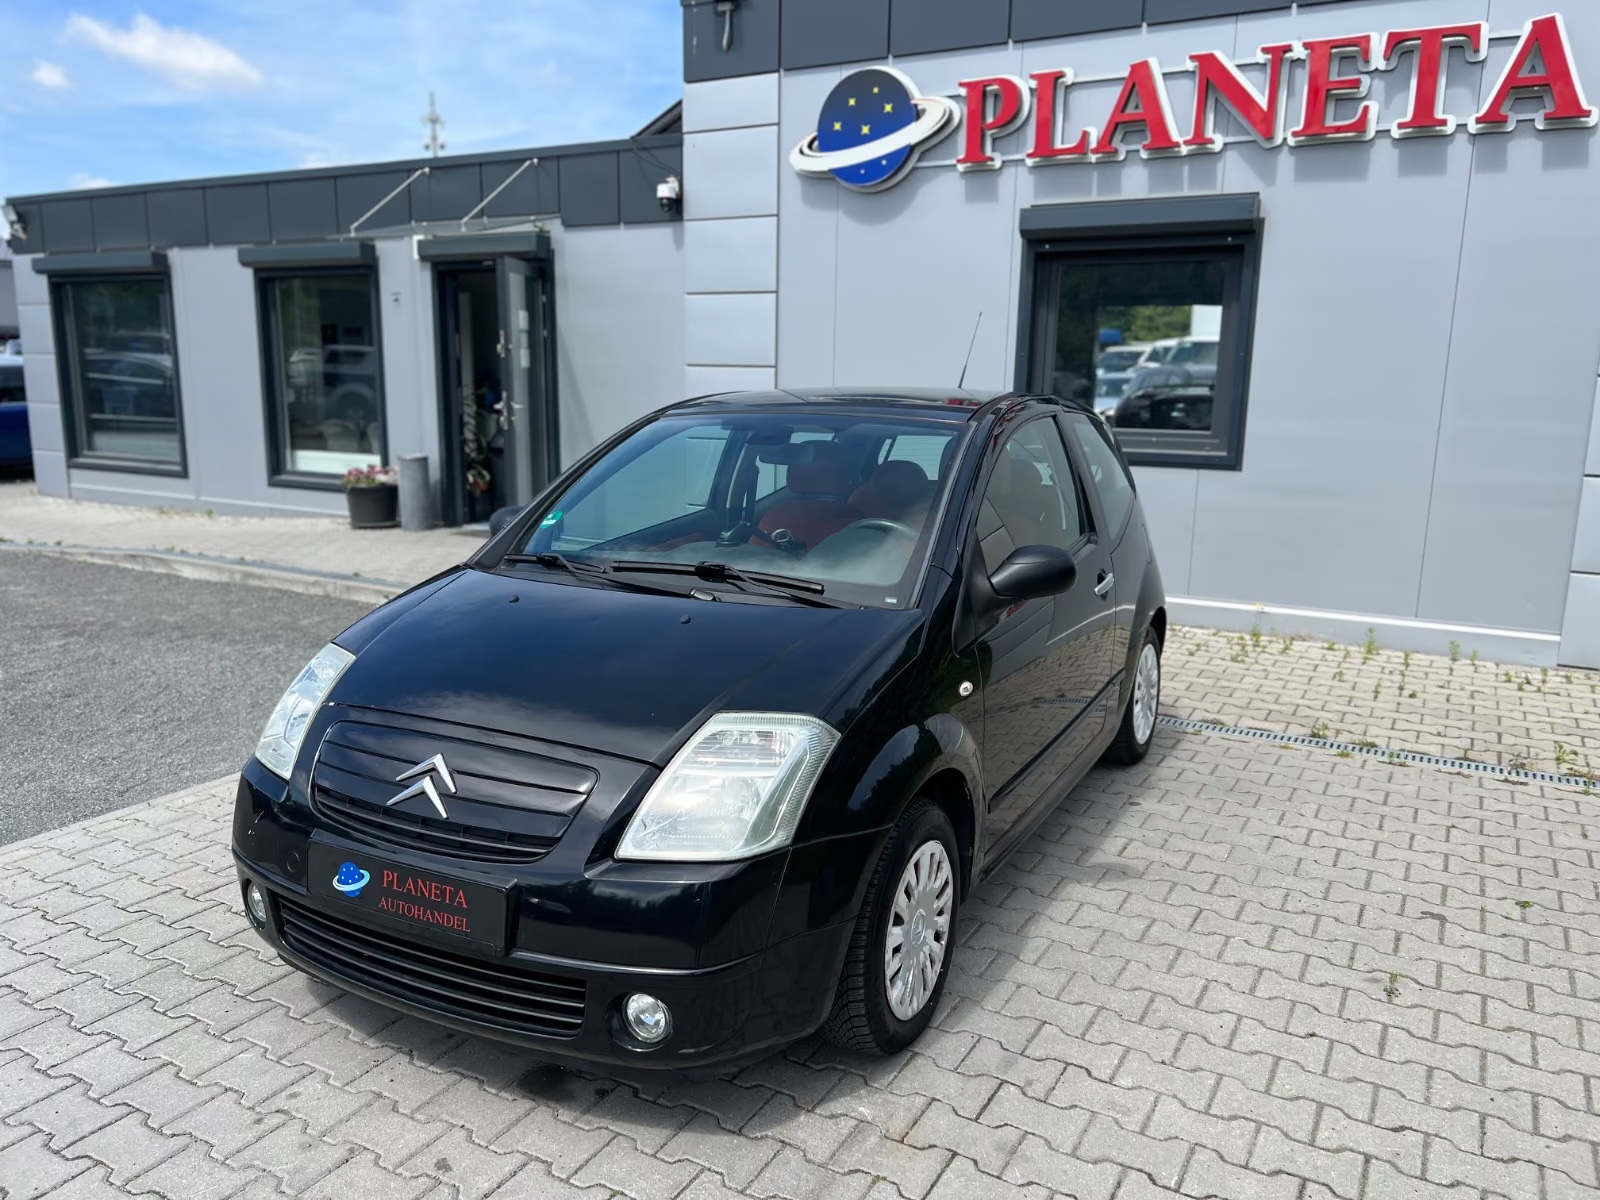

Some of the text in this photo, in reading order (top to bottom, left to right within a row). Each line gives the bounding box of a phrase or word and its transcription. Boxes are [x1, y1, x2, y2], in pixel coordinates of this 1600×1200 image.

[957, 14, 1592, 169] PLANETA
[382, 869, 469, 909] PLANETA
[378, 896, 472, 932] AUTOHANDEL
